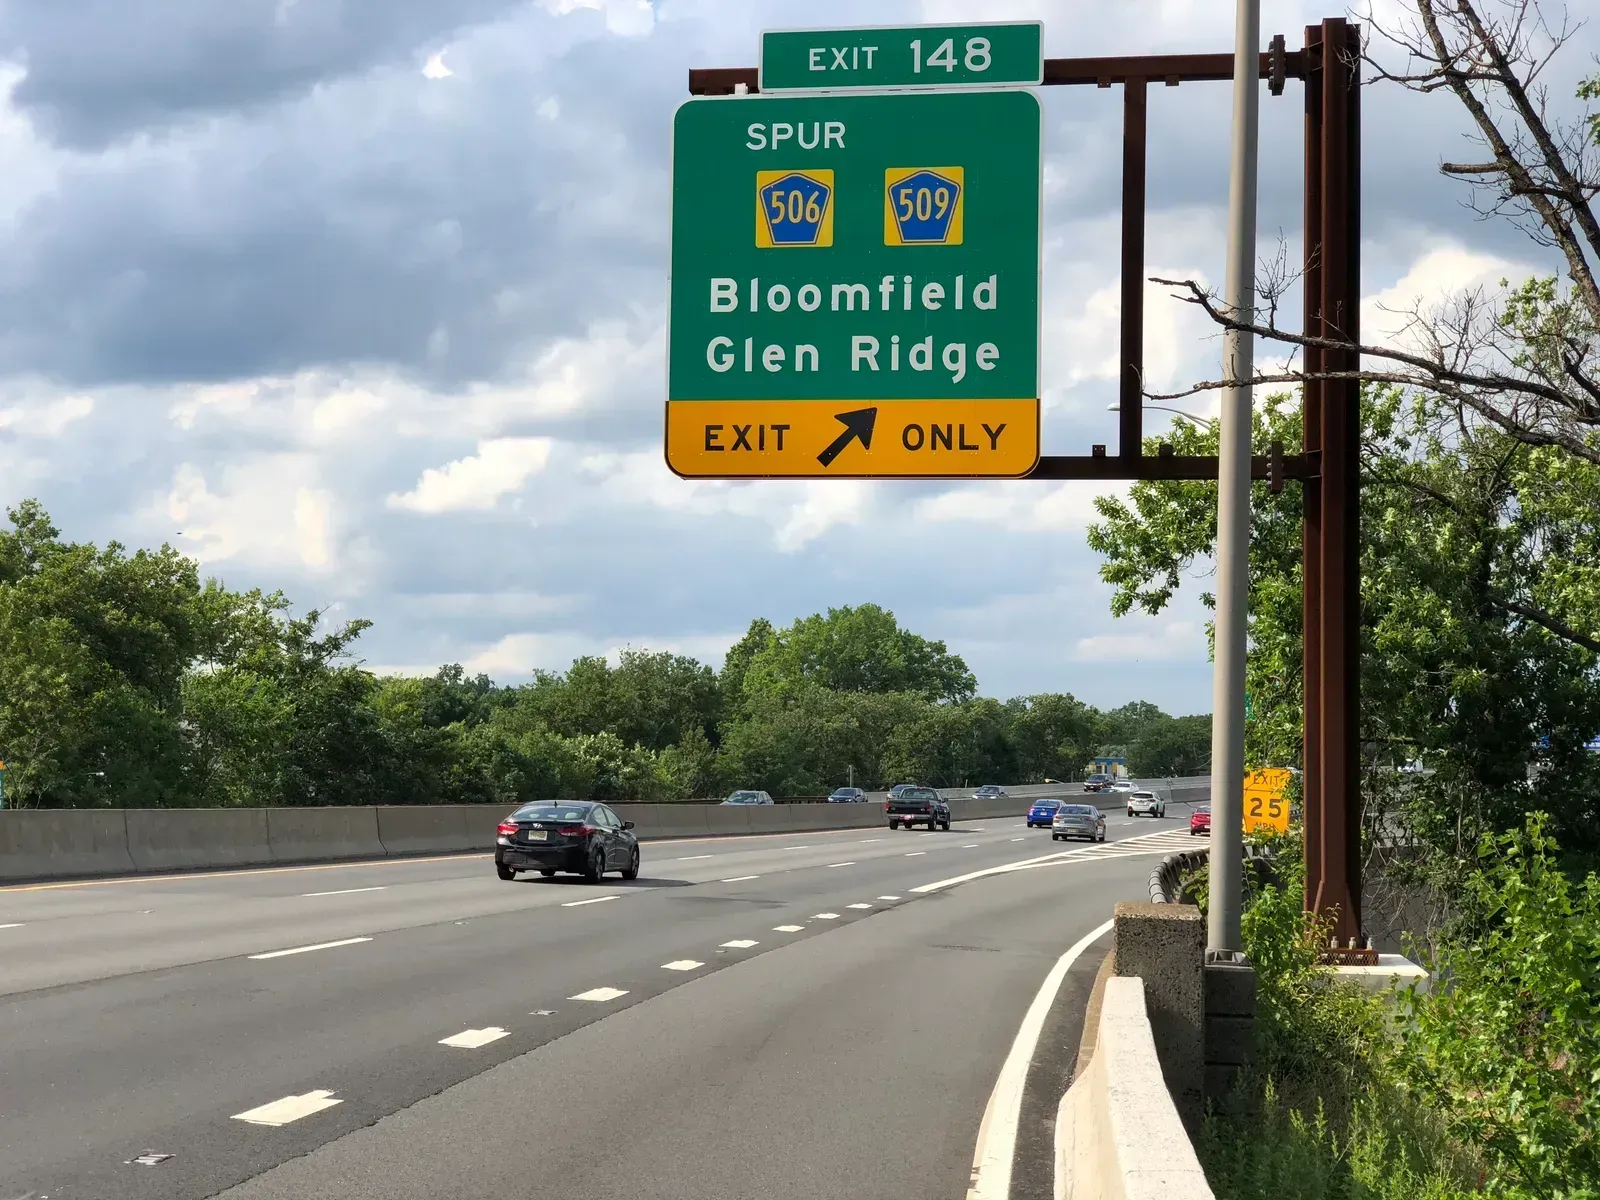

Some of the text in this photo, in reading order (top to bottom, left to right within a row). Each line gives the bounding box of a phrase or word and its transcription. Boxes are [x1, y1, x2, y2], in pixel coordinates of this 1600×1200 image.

[808, 37, 992, 73] EXIT 148
[745, 121, 846, 150] SPUR
[771, 190, 820, 224] 506
[899, 187, 949, 222] 509
[709, 274, 998, 313] Bloomfield
[706, 335, 1000, 384] Glen Ridge
[704, 423, 1007, 452] EXIT ONLY
[1253, 775, 1280, 785] EXIT
[1250, 797, 1282, 818] 25
